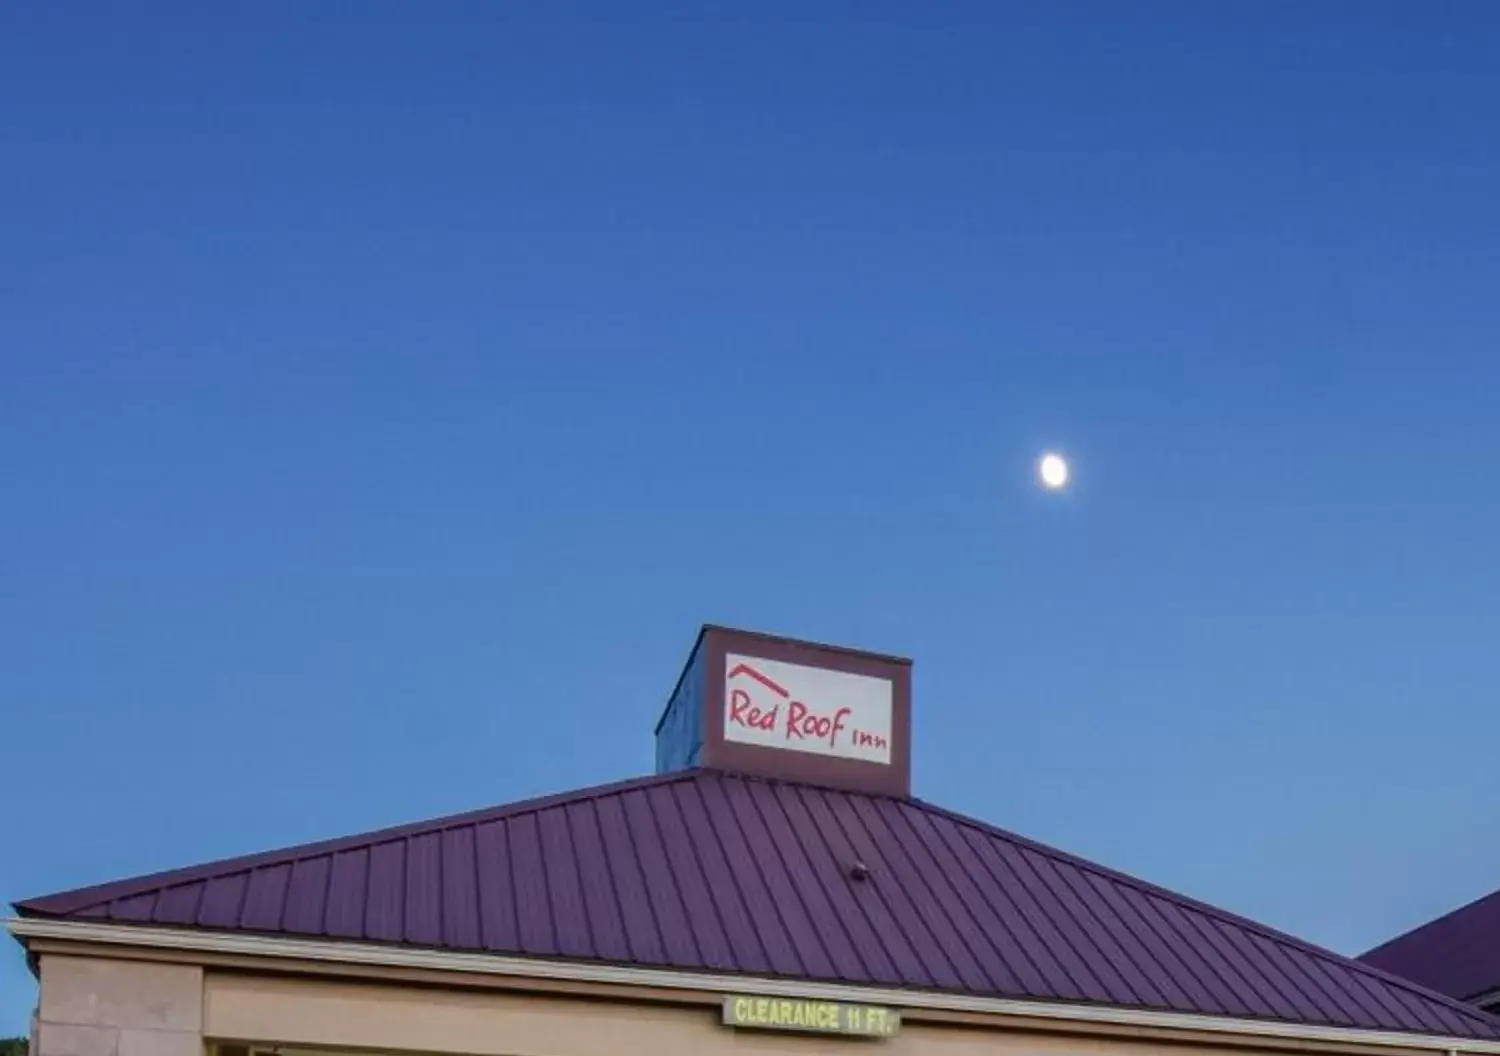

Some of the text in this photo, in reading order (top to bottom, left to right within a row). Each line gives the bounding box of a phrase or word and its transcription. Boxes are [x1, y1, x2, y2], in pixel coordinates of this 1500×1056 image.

[730, 689, 777, 731] Red
[786, 701, 851, 747] Roof
[735, 999, 840, 1028] CLEARANCE
